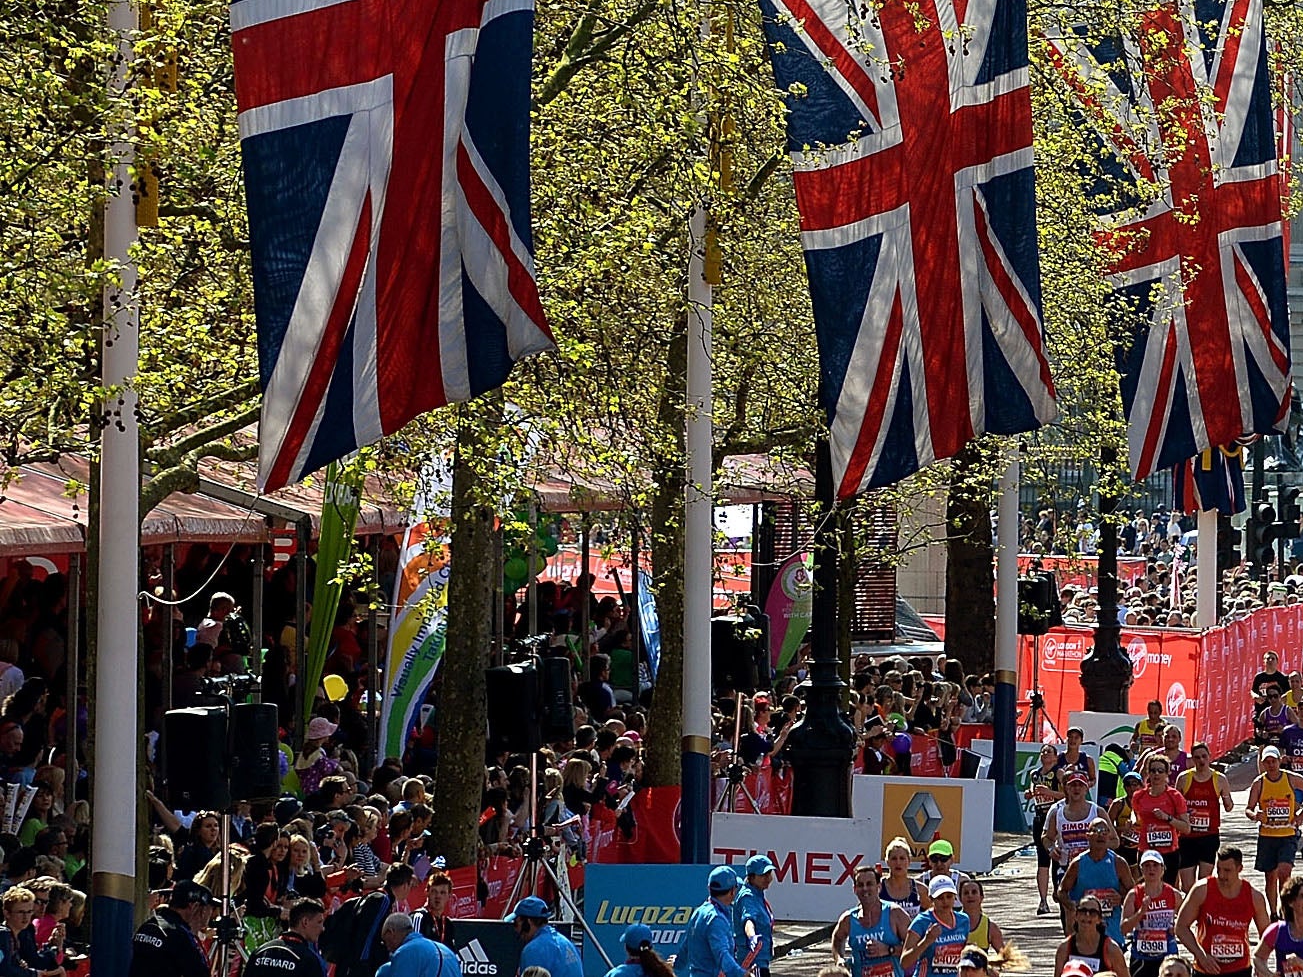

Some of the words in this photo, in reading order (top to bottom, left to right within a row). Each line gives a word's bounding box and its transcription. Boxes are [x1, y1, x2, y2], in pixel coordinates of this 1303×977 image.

[1057, 642, 1077, 650] LONDON
[1147, 654, 1173, 668] money
[1267, 807, 1290, 816] 56030
[595, 900, 692, 926] Lucoza
[856, 931, 885, 944] TONY
[1140, 941, 1164, 951] 8398
[1212, 944, 1243, 956] 53634
[254, 957, 296, 971] STEWARD
[460, 960, 498, 975] didas
